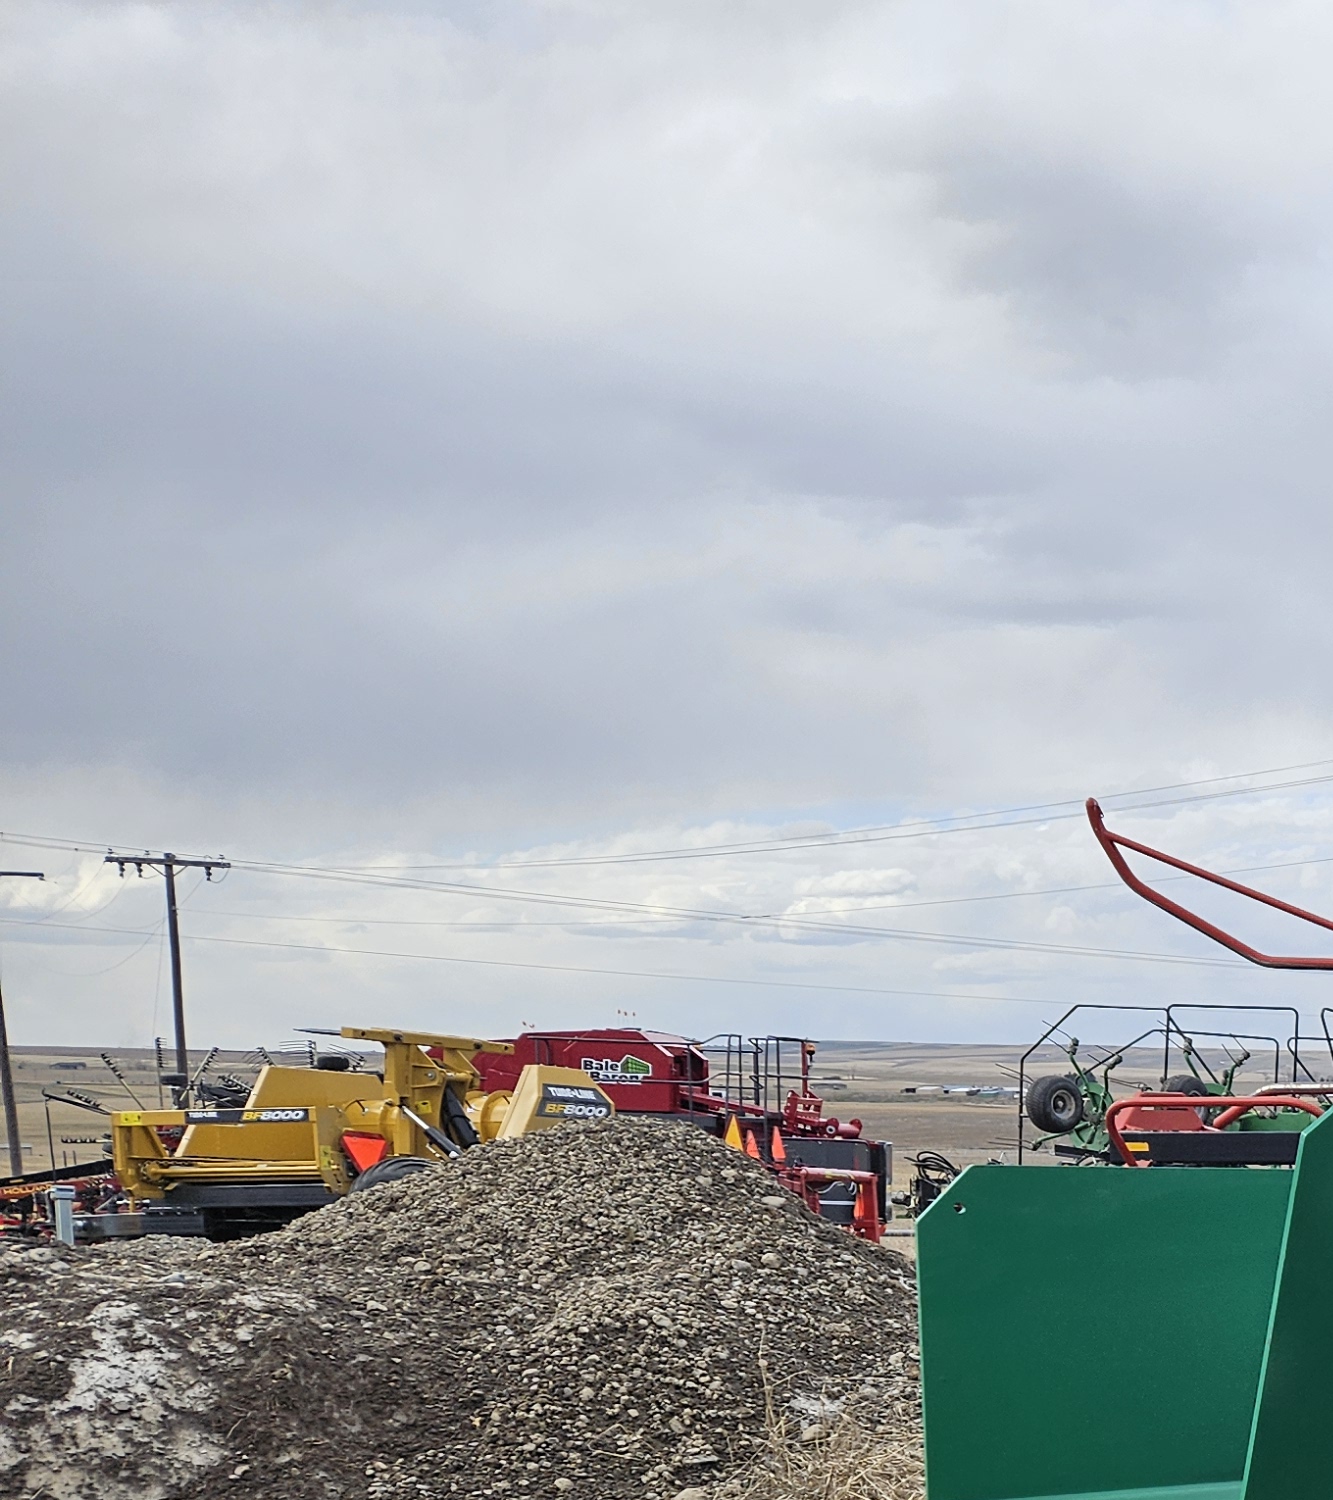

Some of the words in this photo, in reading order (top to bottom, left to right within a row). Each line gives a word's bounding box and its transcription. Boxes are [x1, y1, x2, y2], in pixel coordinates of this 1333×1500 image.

[583, 1060, 620, 1072] Bale
[242, 1110, 304, 1121] BF8000
[544, 1103, 608, 1116] BF8000
